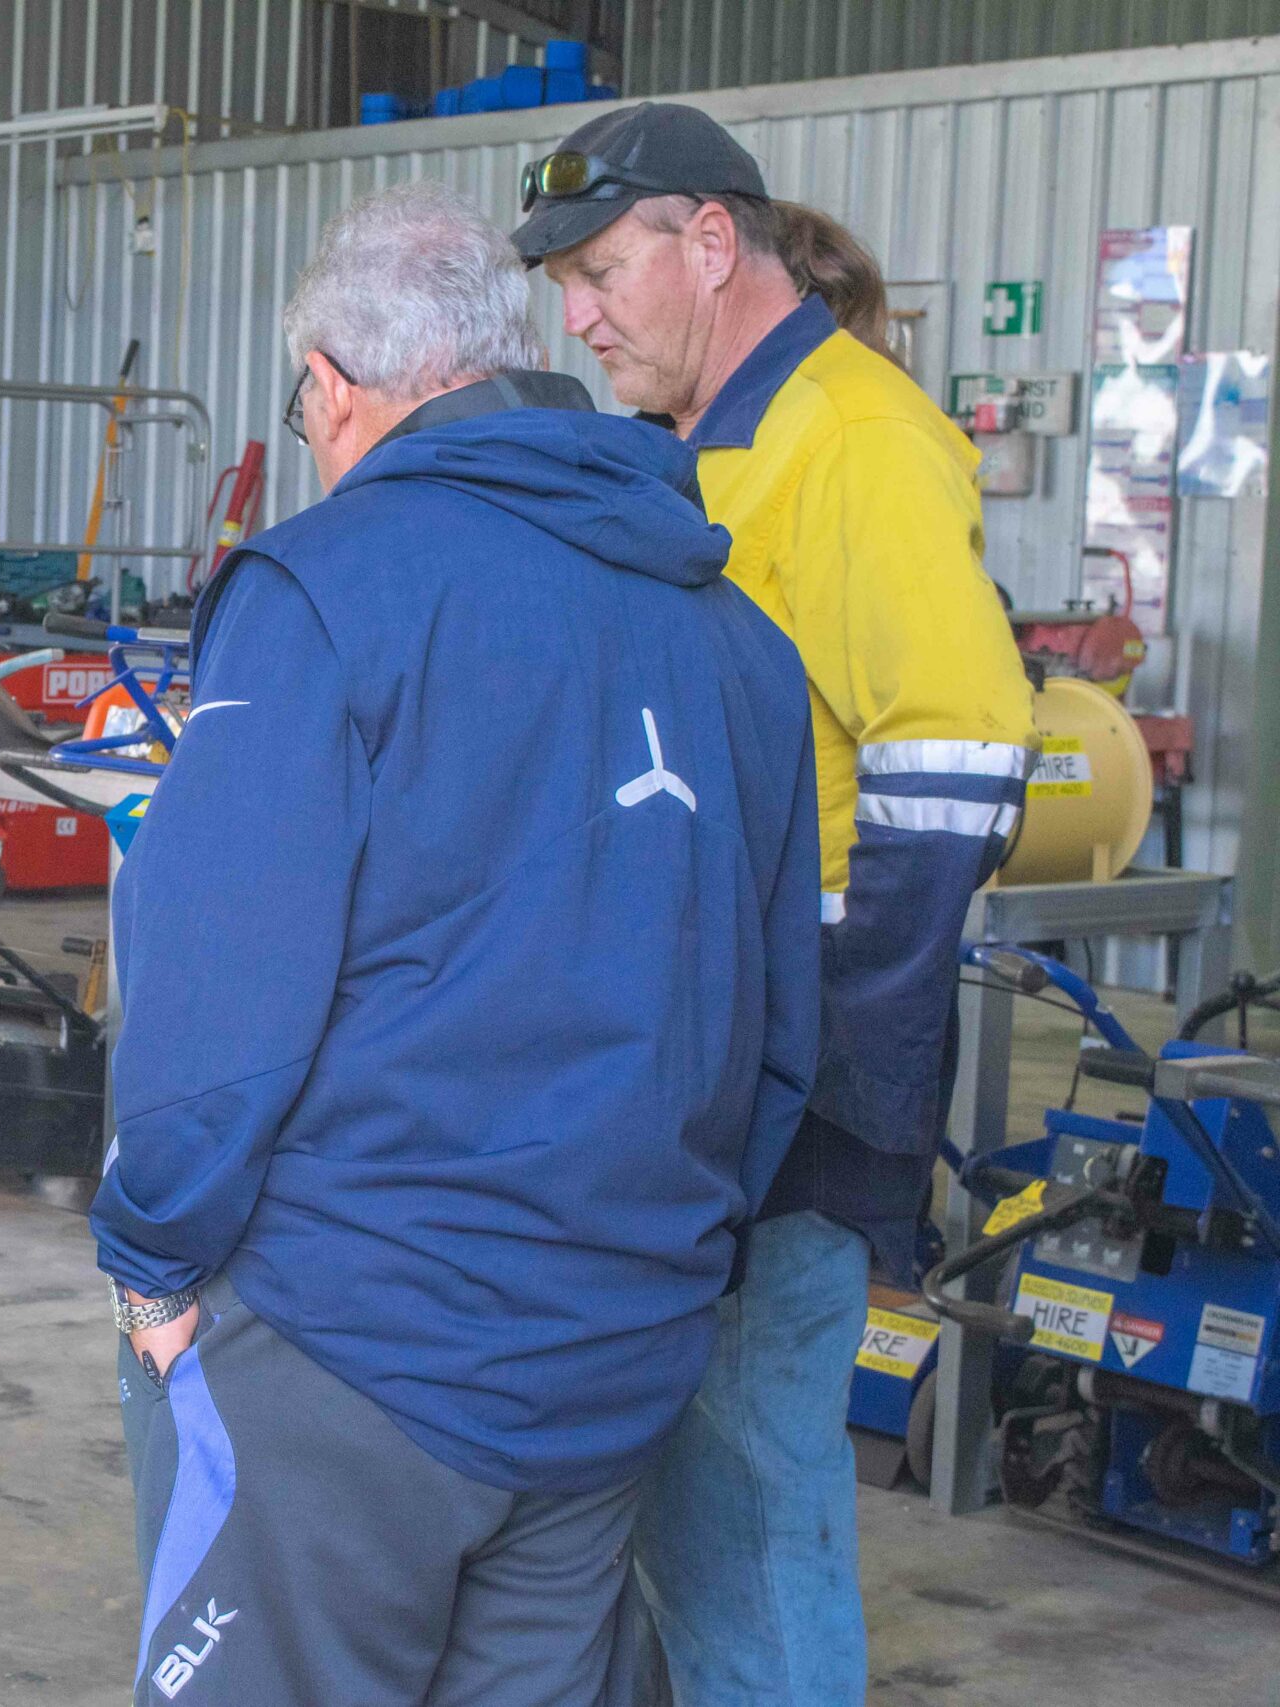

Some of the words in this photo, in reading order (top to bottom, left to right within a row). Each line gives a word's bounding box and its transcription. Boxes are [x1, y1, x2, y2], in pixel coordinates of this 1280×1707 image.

[1035, 755, 1077, 780] HIRE
[1032, 1300, 1088, 1336] HIRE
[152, 1597, 238, 1699] BLK
